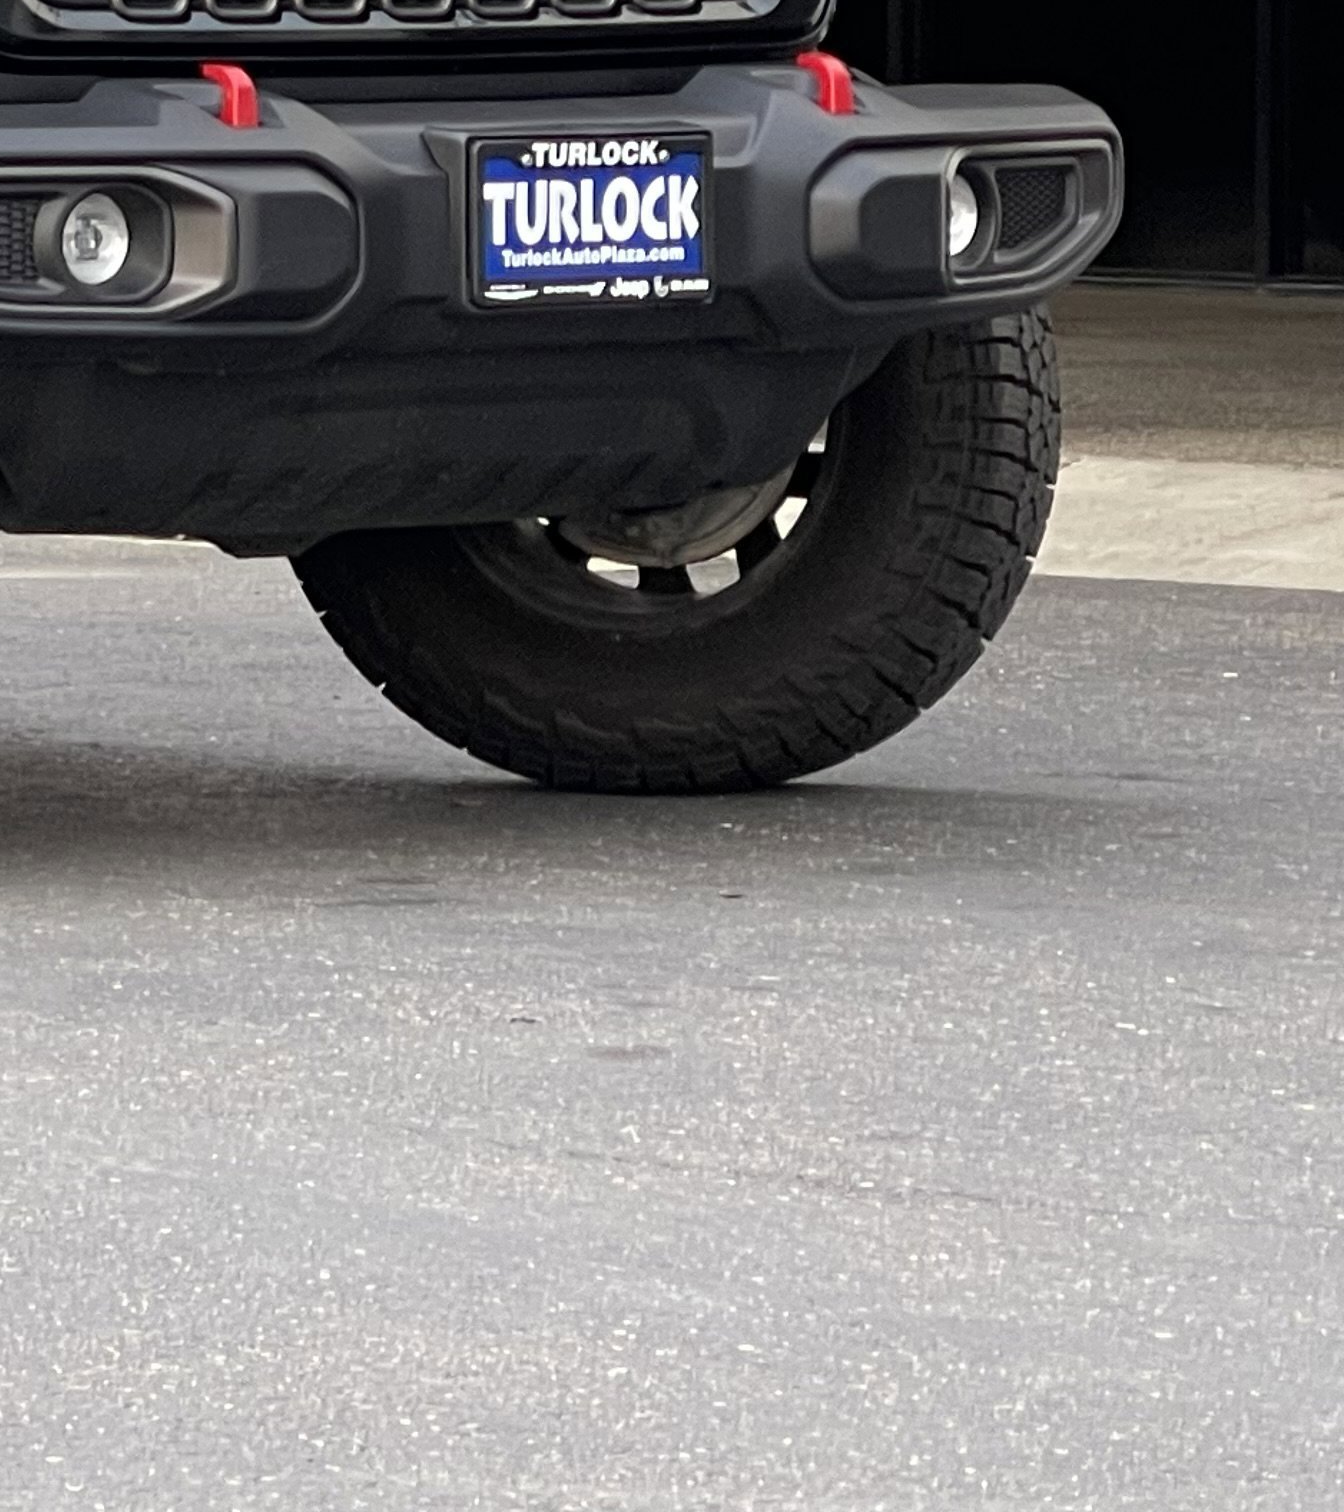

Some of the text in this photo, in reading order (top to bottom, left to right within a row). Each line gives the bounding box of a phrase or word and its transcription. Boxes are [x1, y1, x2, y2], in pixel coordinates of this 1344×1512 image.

[531, 140, 661, 168] TURLOCK
[483, 175, 700, 246] TURLOCK
[502, 245, 685, 268] TurlockAutoPlaza.com
